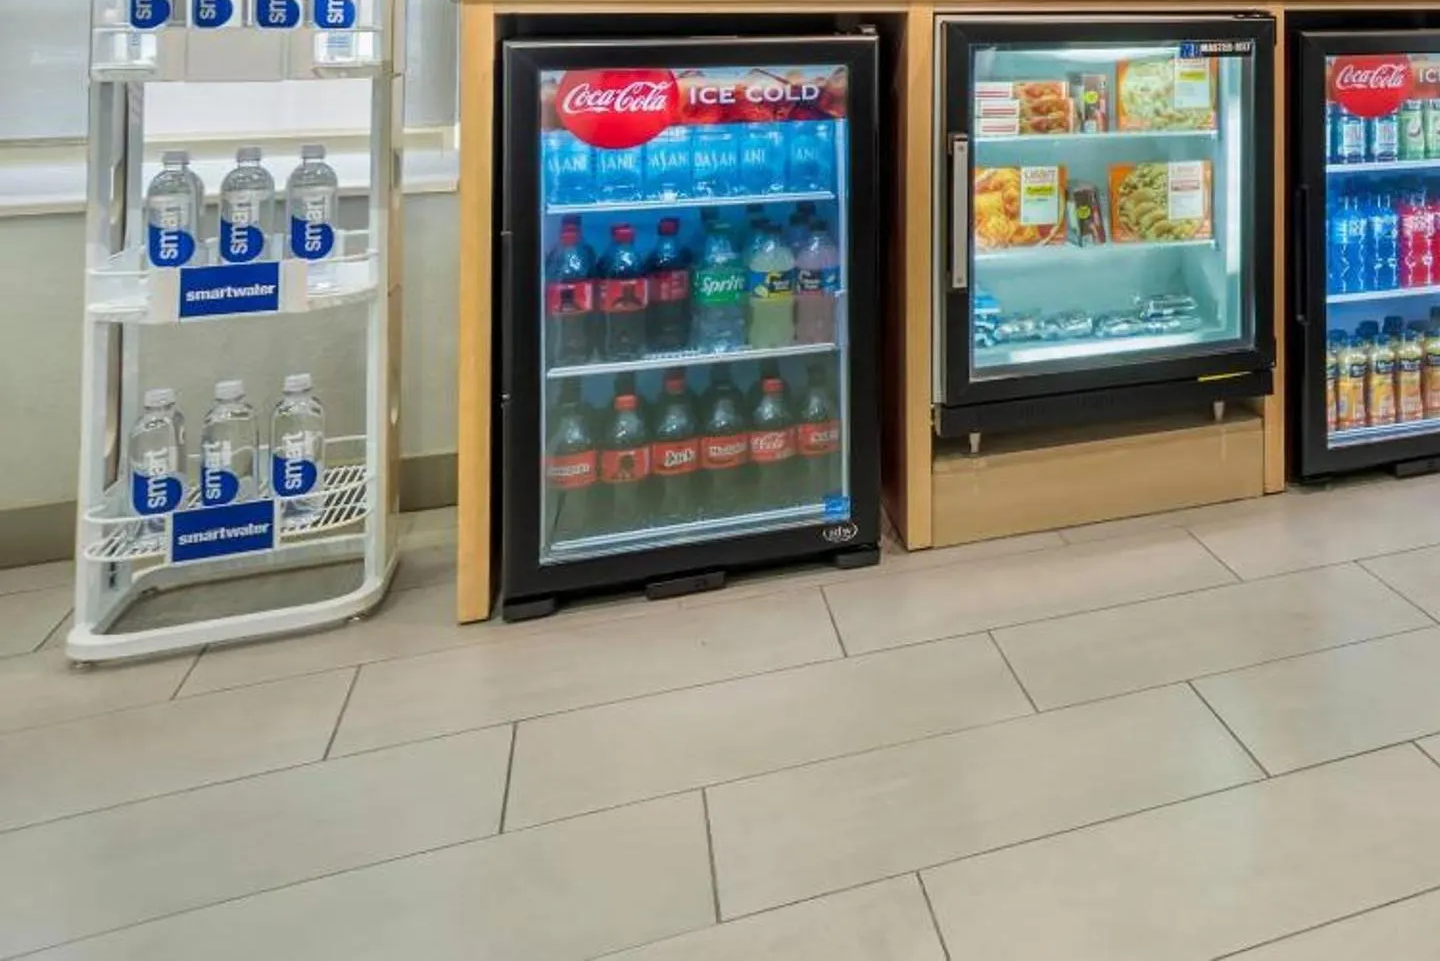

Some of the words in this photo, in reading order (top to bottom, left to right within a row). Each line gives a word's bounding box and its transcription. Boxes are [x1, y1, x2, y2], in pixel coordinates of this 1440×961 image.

[689, 88, 736, 104] ICE
[745, 85, 820, 103] COLD
[185, 284, 276, 302] smartwater
[177, 521, 272, 546] smartwater
